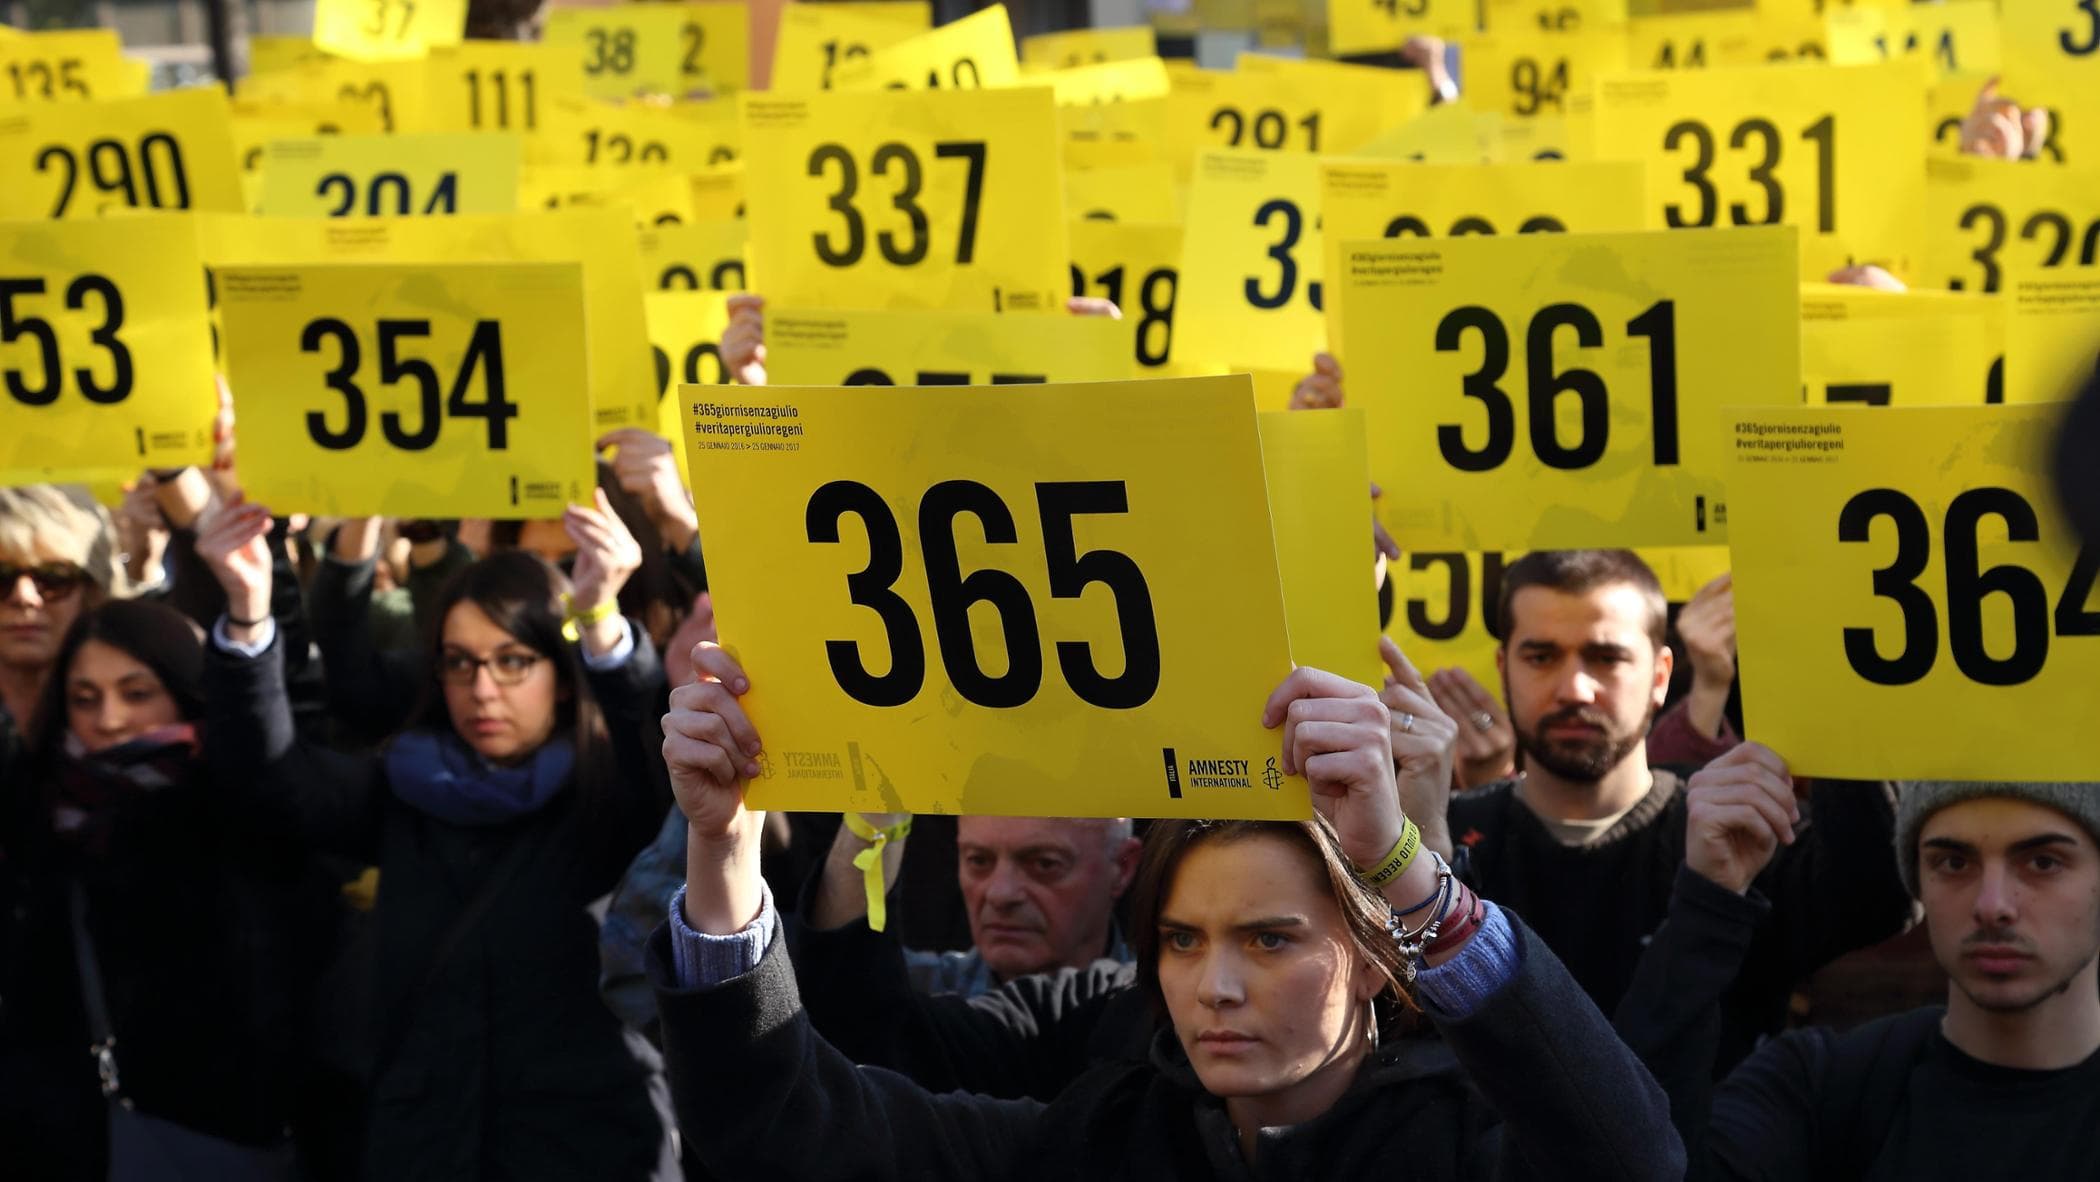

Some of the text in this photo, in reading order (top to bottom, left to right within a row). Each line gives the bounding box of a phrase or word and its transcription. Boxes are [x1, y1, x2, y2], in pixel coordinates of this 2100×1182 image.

[464, 68, 538, 129] 111
[807, 141, 988, 268] 337
[1663, 116, 1836, 234] 331
[0, 274, 135, 406] 53
[300, 317, 519, 451] 354
[1435, 299, 1680, 472] 361
[693, 403, 798, 419] #365giornisenzagiulio
[695, 421, 803, 437] #veritapergiulioregeni
[805, 479, 1161, 710] 365
[1188, 760, 1248, 775] AMNESTY
[1190, 778, 1252, 788] INTERNATIONAL
